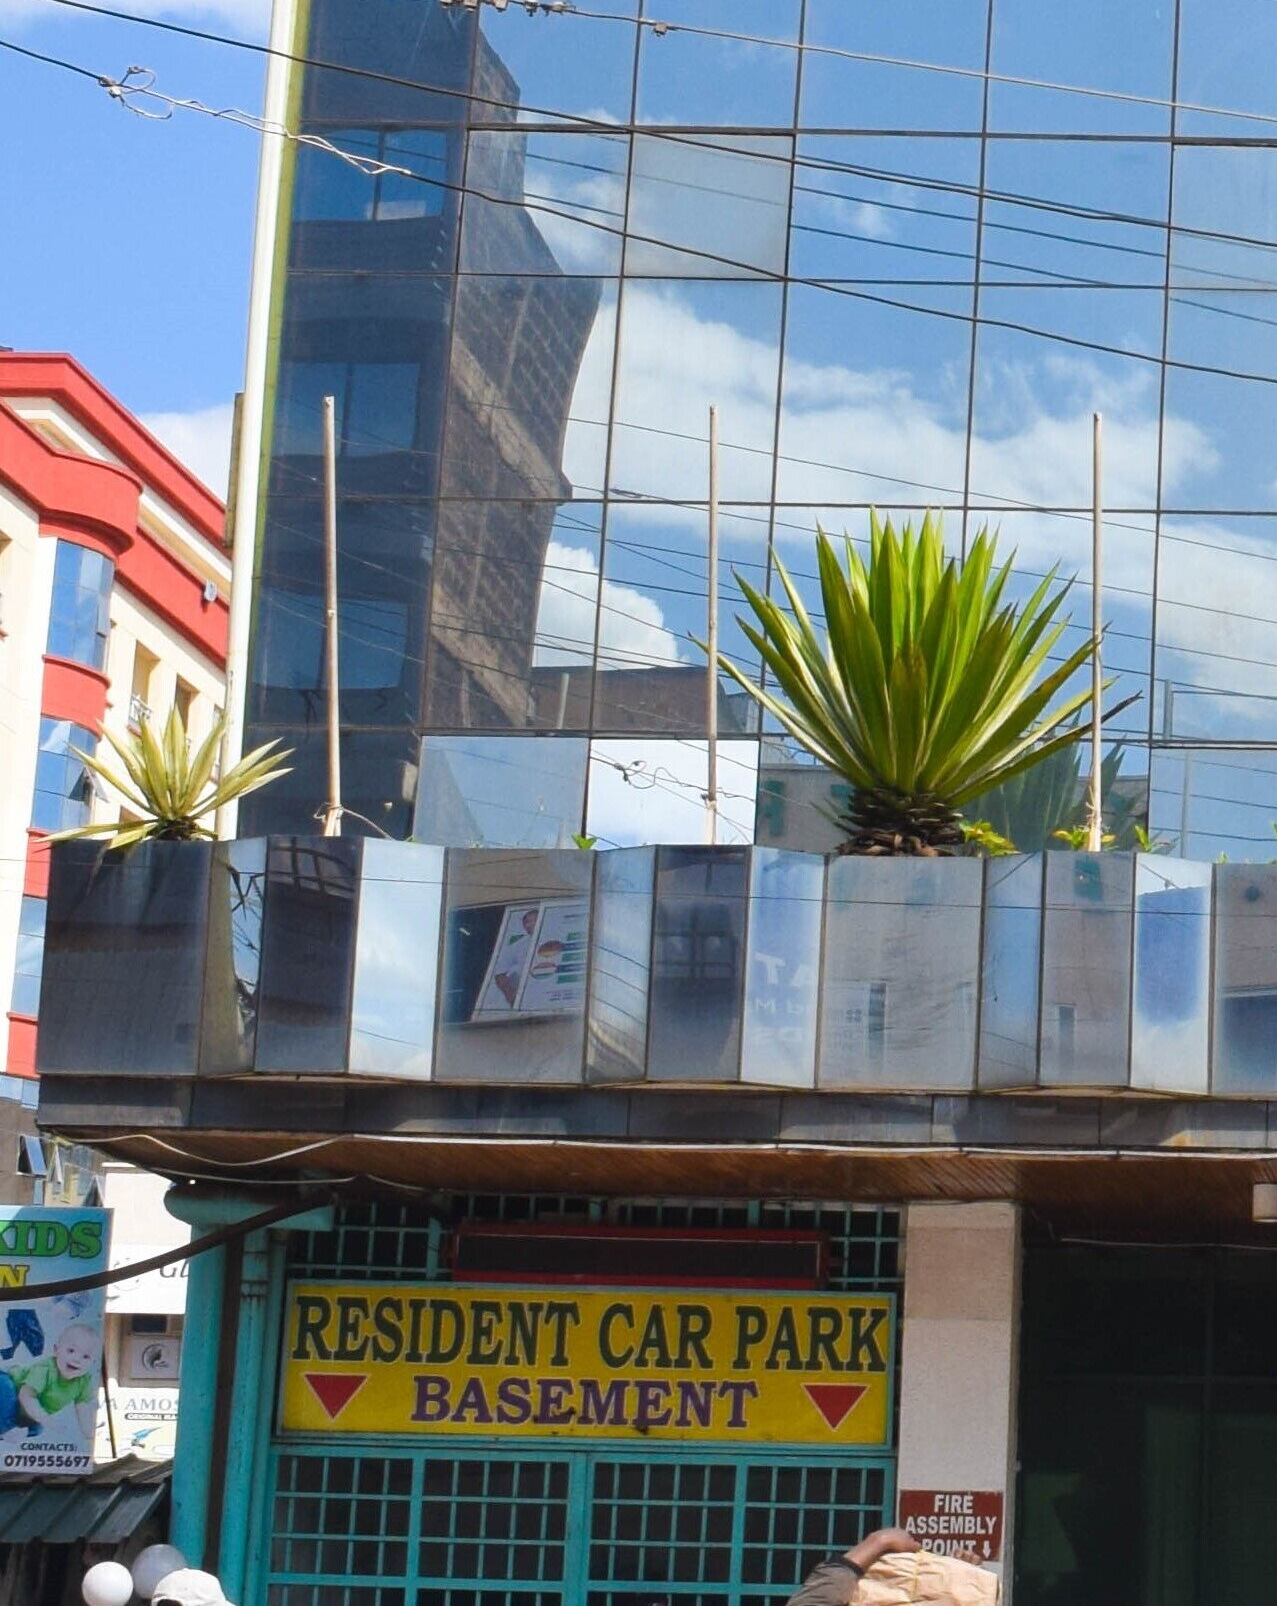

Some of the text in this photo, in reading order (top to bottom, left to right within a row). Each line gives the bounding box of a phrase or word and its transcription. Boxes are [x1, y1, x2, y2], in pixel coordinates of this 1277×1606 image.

[292, 1295, 889, 1373] RESIDENT CAR PARK
[411, 1374, 759, 1428] BASEMENT
[4, 1455, 91, 1467] 0719555697
[933, 1494, 975, 1514] FIRE
[905, 1516, 997, 1535] ASSEMBLY
